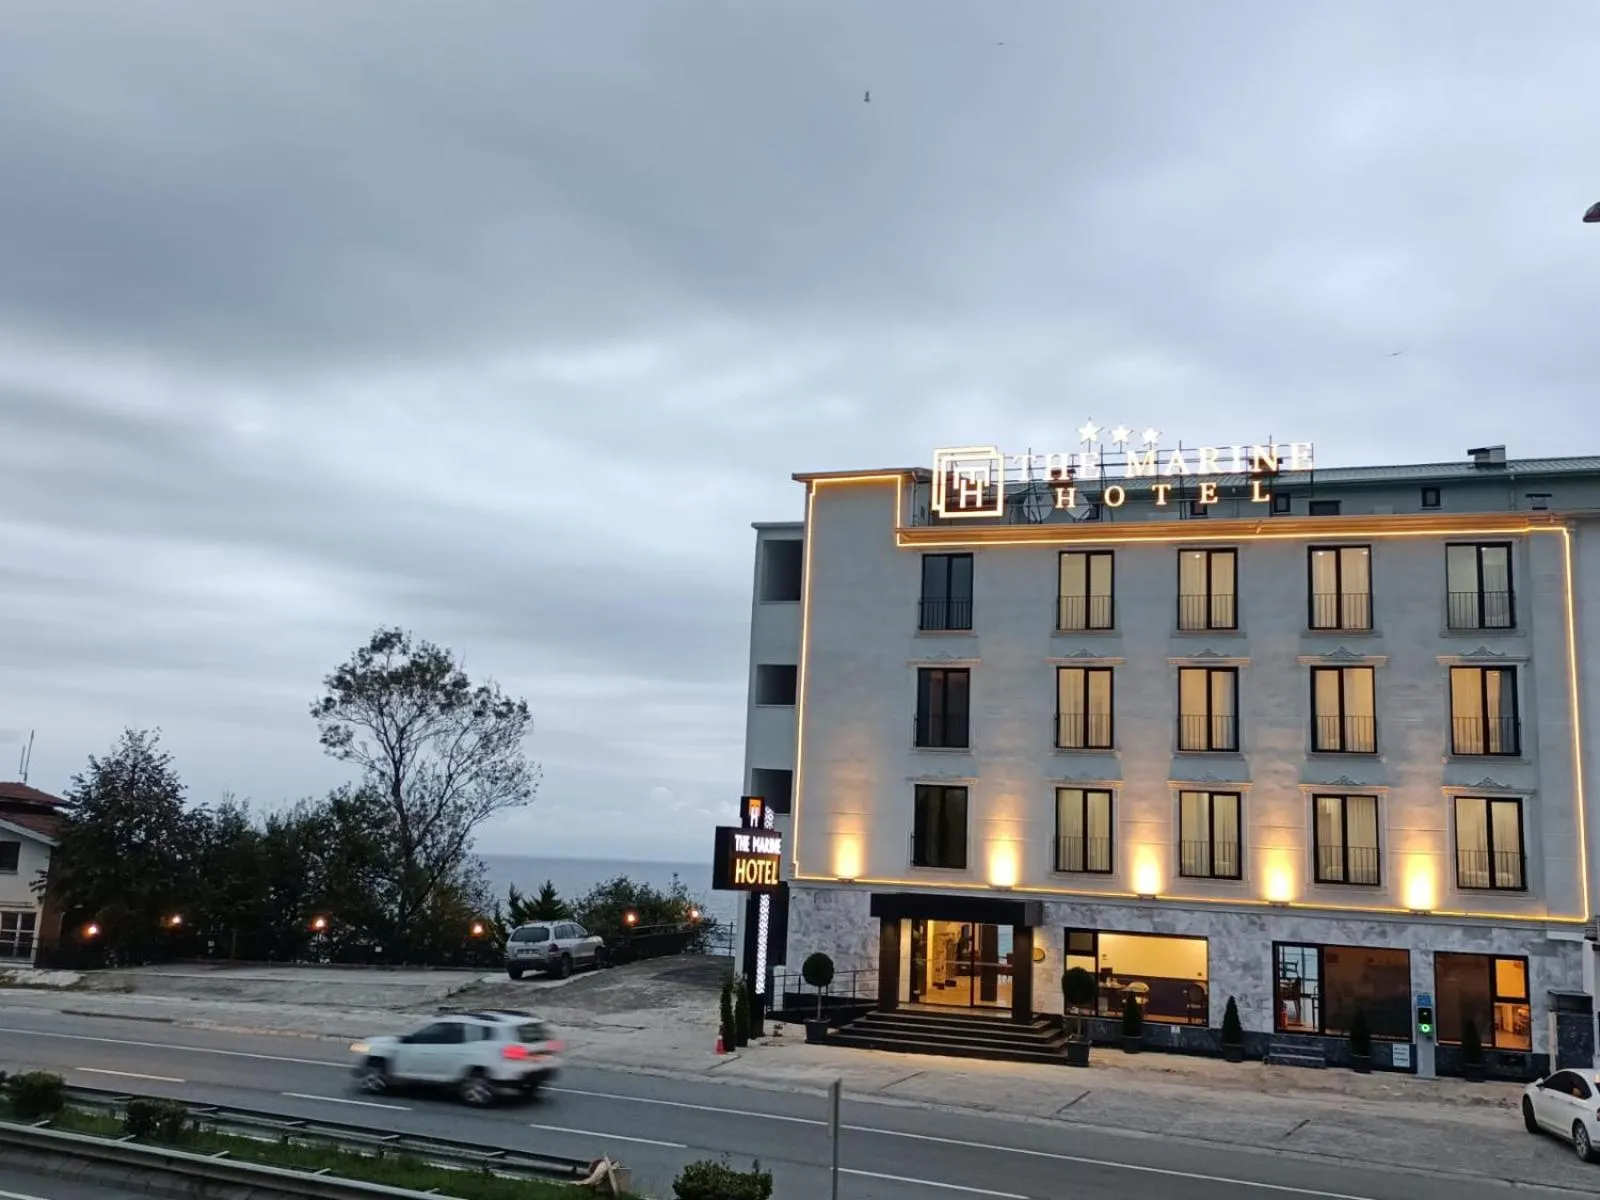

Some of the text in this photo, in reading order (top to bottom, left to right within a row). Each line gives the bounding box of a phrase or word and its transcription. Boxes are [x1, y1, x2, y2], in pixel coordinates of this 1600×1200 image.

[1013, 442, 1314, 481] THE MARINE
[1055, 480, 1272, 509] HOTEL
[734, 834, 782, 854] THE MARINE
[735, 858, 779, 885] HOTEL
